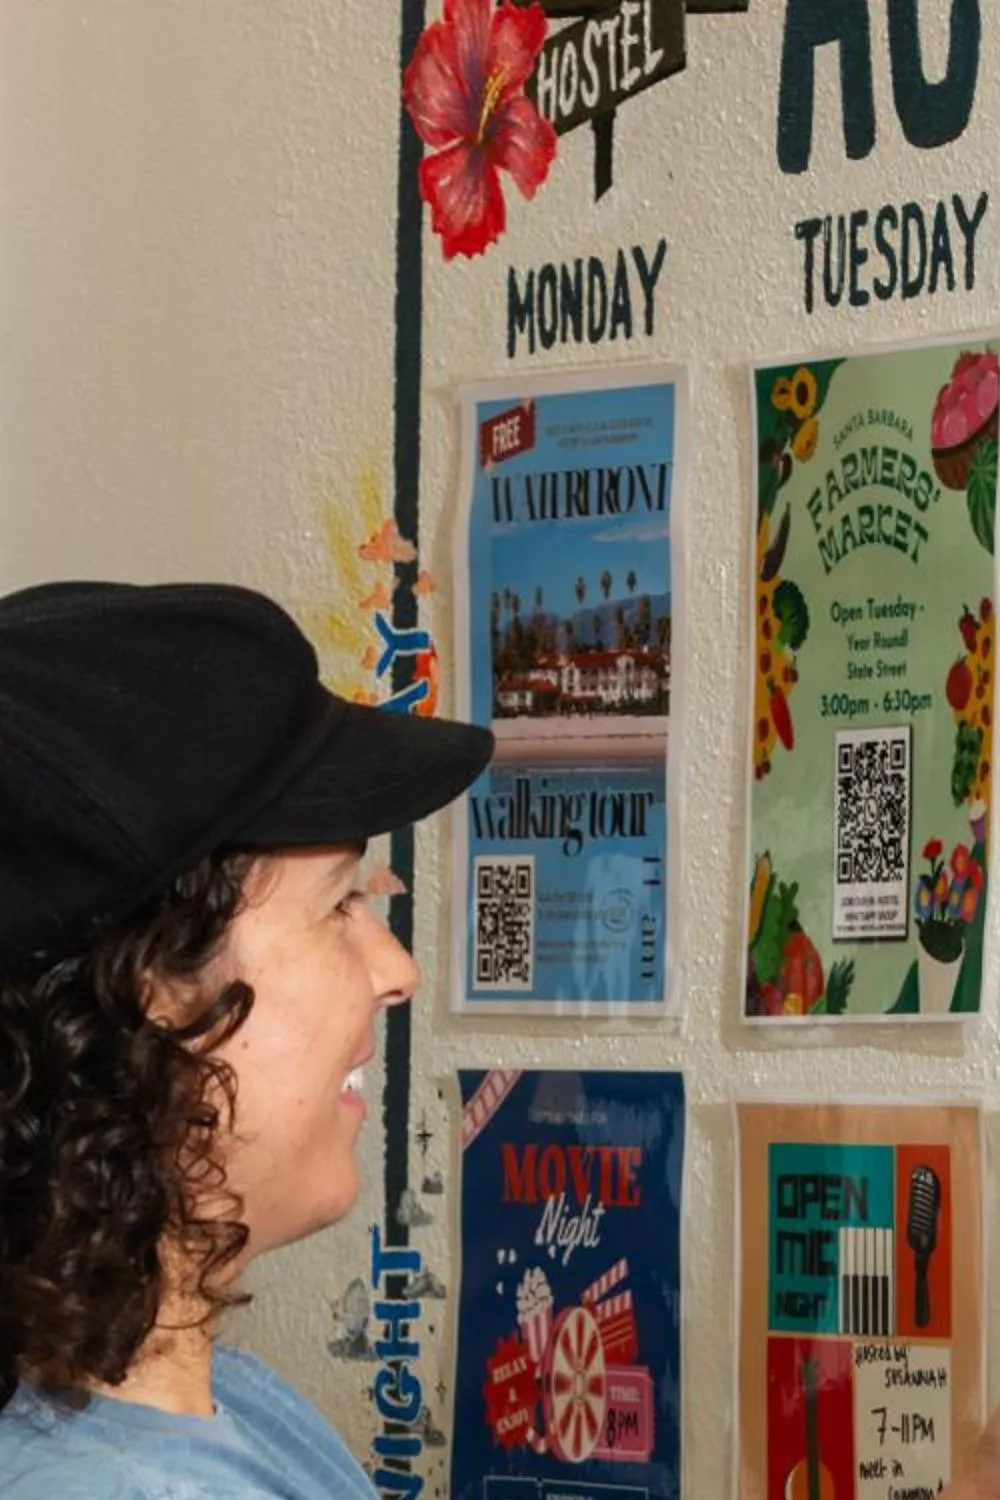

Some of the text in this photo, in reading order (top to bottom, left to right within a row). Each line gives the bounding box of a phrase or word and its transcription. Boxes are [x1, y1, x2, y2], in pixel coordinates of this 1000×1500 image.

[537, 0, 664, 122] HOSTEL
[794, 191, 988, 313] TUESDAY
[507, 239, 666, 358] MONDAY
[491, 415, 522, 455] FREE
[833, 408, 915, 448] SANTA BARBARA
[818, 503, 930, 576] MARKET
[830, 595, 917, 626] Open Tuesday
[847, 629, 909, 652] Year Round
[847, 661, 908, 680] State Street
[820, 693, 870, 719] 3:00pm
[590, 786, 654, 838] tour
[502, 1142, 642, 1208] MOVIE
[777, 1174, 869, 1222] OPEN
[535, 1192, 605, 1266] Night
[776, 1229, 839, 1277] MIC
[776, 1291, 828, 1318] NIGHT
